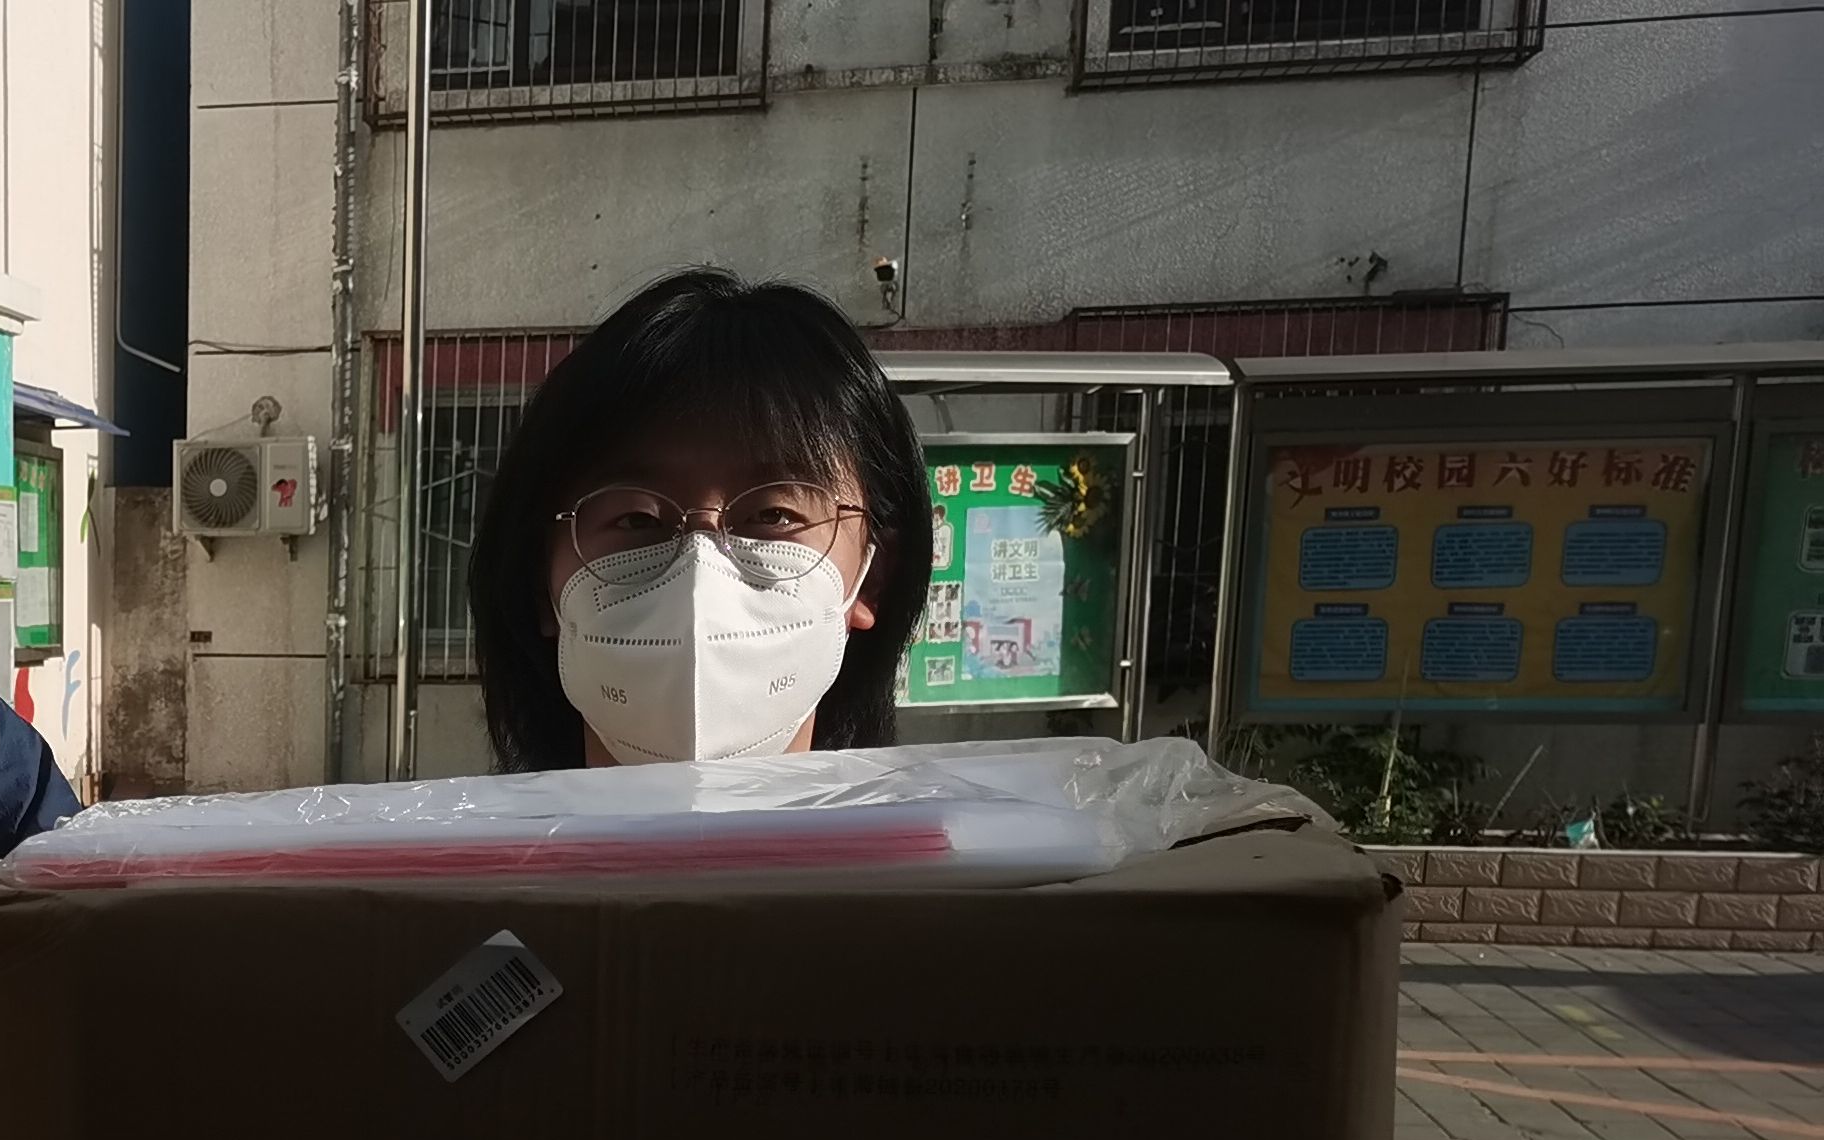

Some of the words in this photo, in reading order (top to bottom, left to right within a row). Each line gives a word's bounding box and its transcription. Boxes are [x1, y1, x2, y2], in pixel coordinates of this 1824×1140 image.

[935, 463, 1038, 496] 讲卫生
[1281, 448, 1698, 508] 文明校园六好标准
[992, 538, 1039, 559] 讲文明
[992, 563, 1039, 583] 讲卫生
[601, 684, 628, 705] N95
[768, 672, 797, 696] N95
